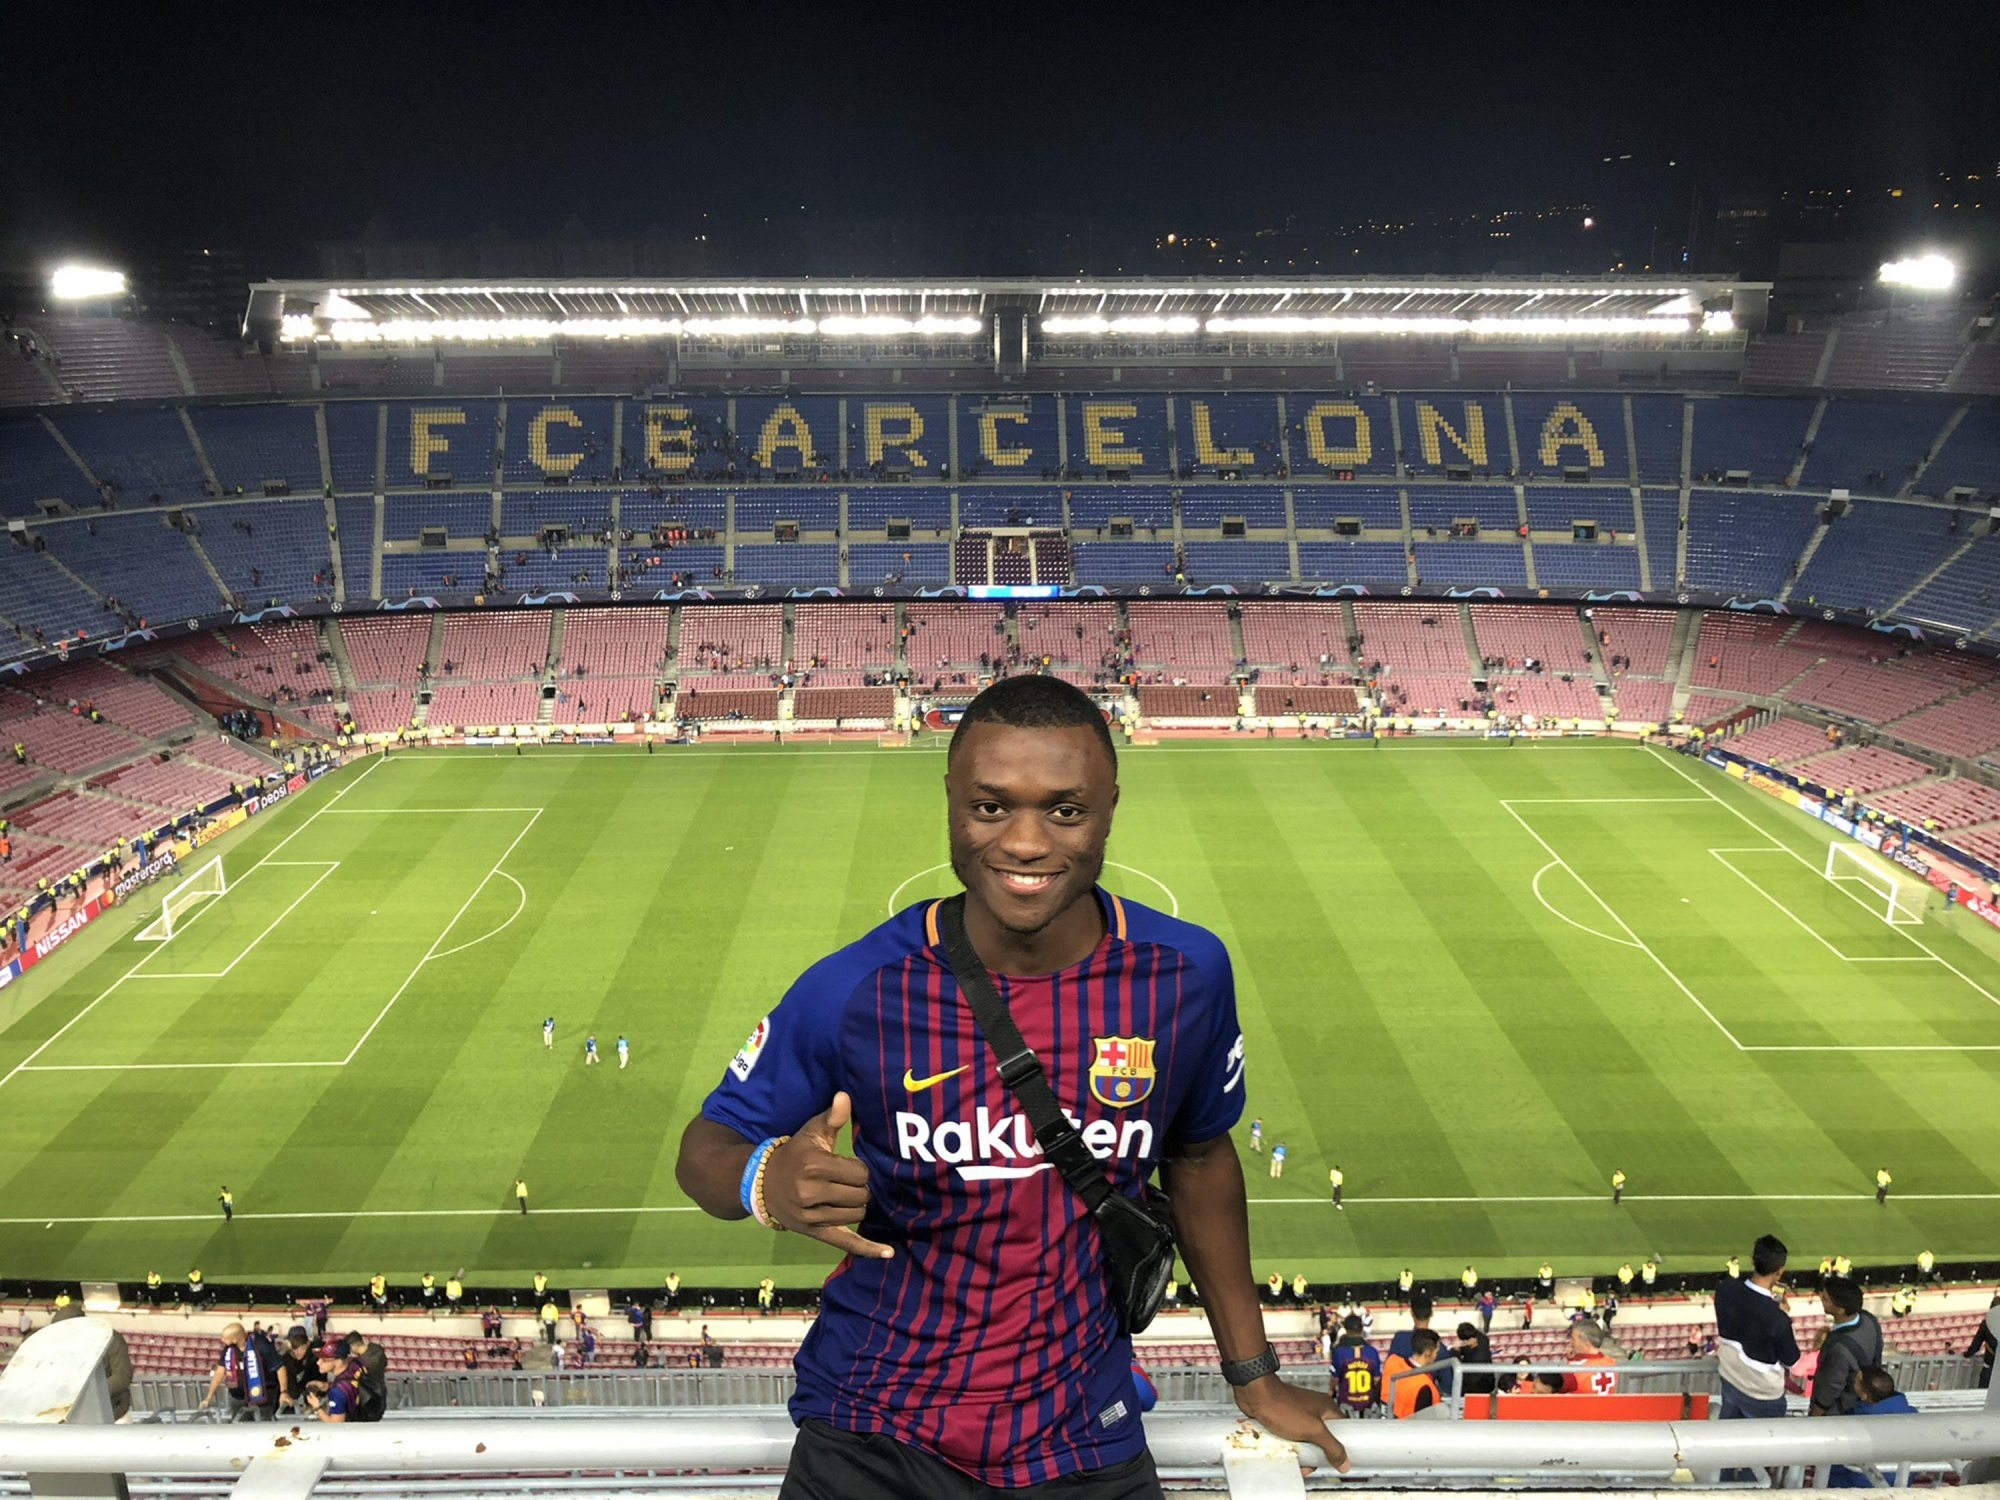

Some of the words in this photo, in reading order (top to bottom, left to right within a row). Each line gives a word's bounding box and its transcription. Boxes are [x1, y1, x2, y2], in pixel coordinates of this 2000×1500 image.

[644, 402, 1605, 474] BARCELONA
[261, 783, 287, 808] pepsi
[114, 850, 173, 895] mastercard
[1894, 849, 1928, 876] pepsi
[36, 909, 87, 948] NISSAN
[1345, 1370, 1371, 1394] 10
